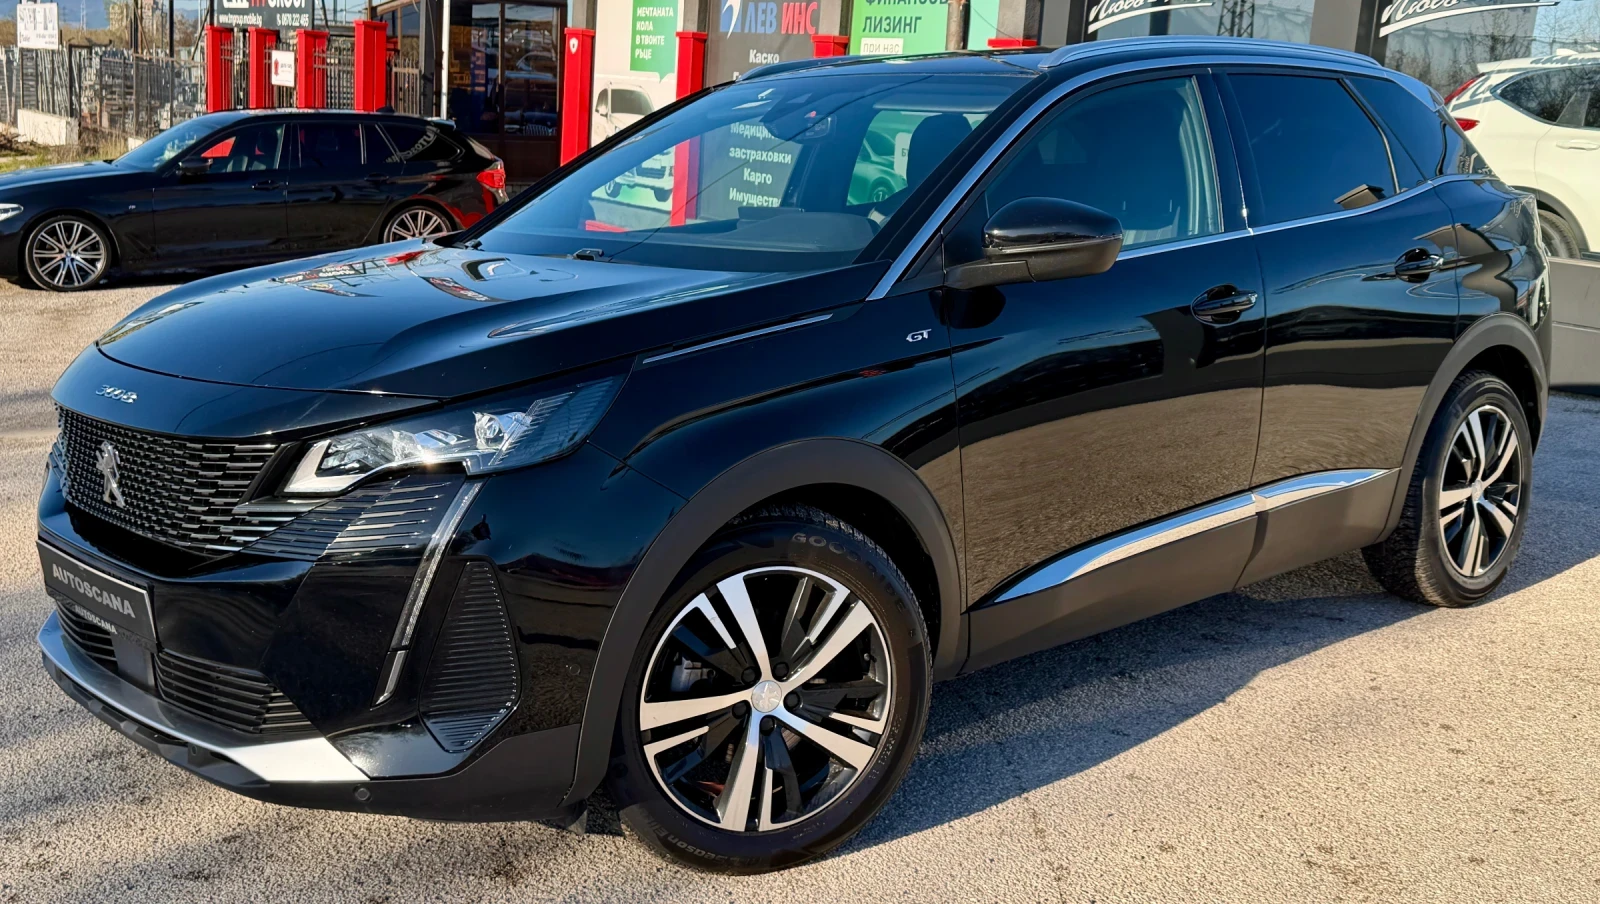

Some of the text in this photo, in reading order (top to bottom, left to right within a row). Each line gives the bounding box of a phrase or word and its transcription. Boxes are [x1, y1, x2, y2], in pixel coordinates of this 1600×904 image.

[637, 6, 674, 17] МЕЧТАНАТА
[744, 1, 818, 35] ЛЕВ ИНС
[636, 21, 654, 31] КОЛА
[862, 16, 922, 33] ЛИЗИНГ
[635, 34, 665, 46] В ТВОИТЕ
[862, 43, 900, 53] при нас
[635, 48, 652, 60] РЪЦЕ
[749, 49, 780, 64] Каско
[729, 147, 792, 164] застраховки
[743, 168, 772, 185] Карго
[905, 328, 932, 342] GT
[95, 384, 138, 403] 3008
[52, 563, 136, 619] AUTOSCANA
[75, 604, 118, 634] AUTOSCANA
